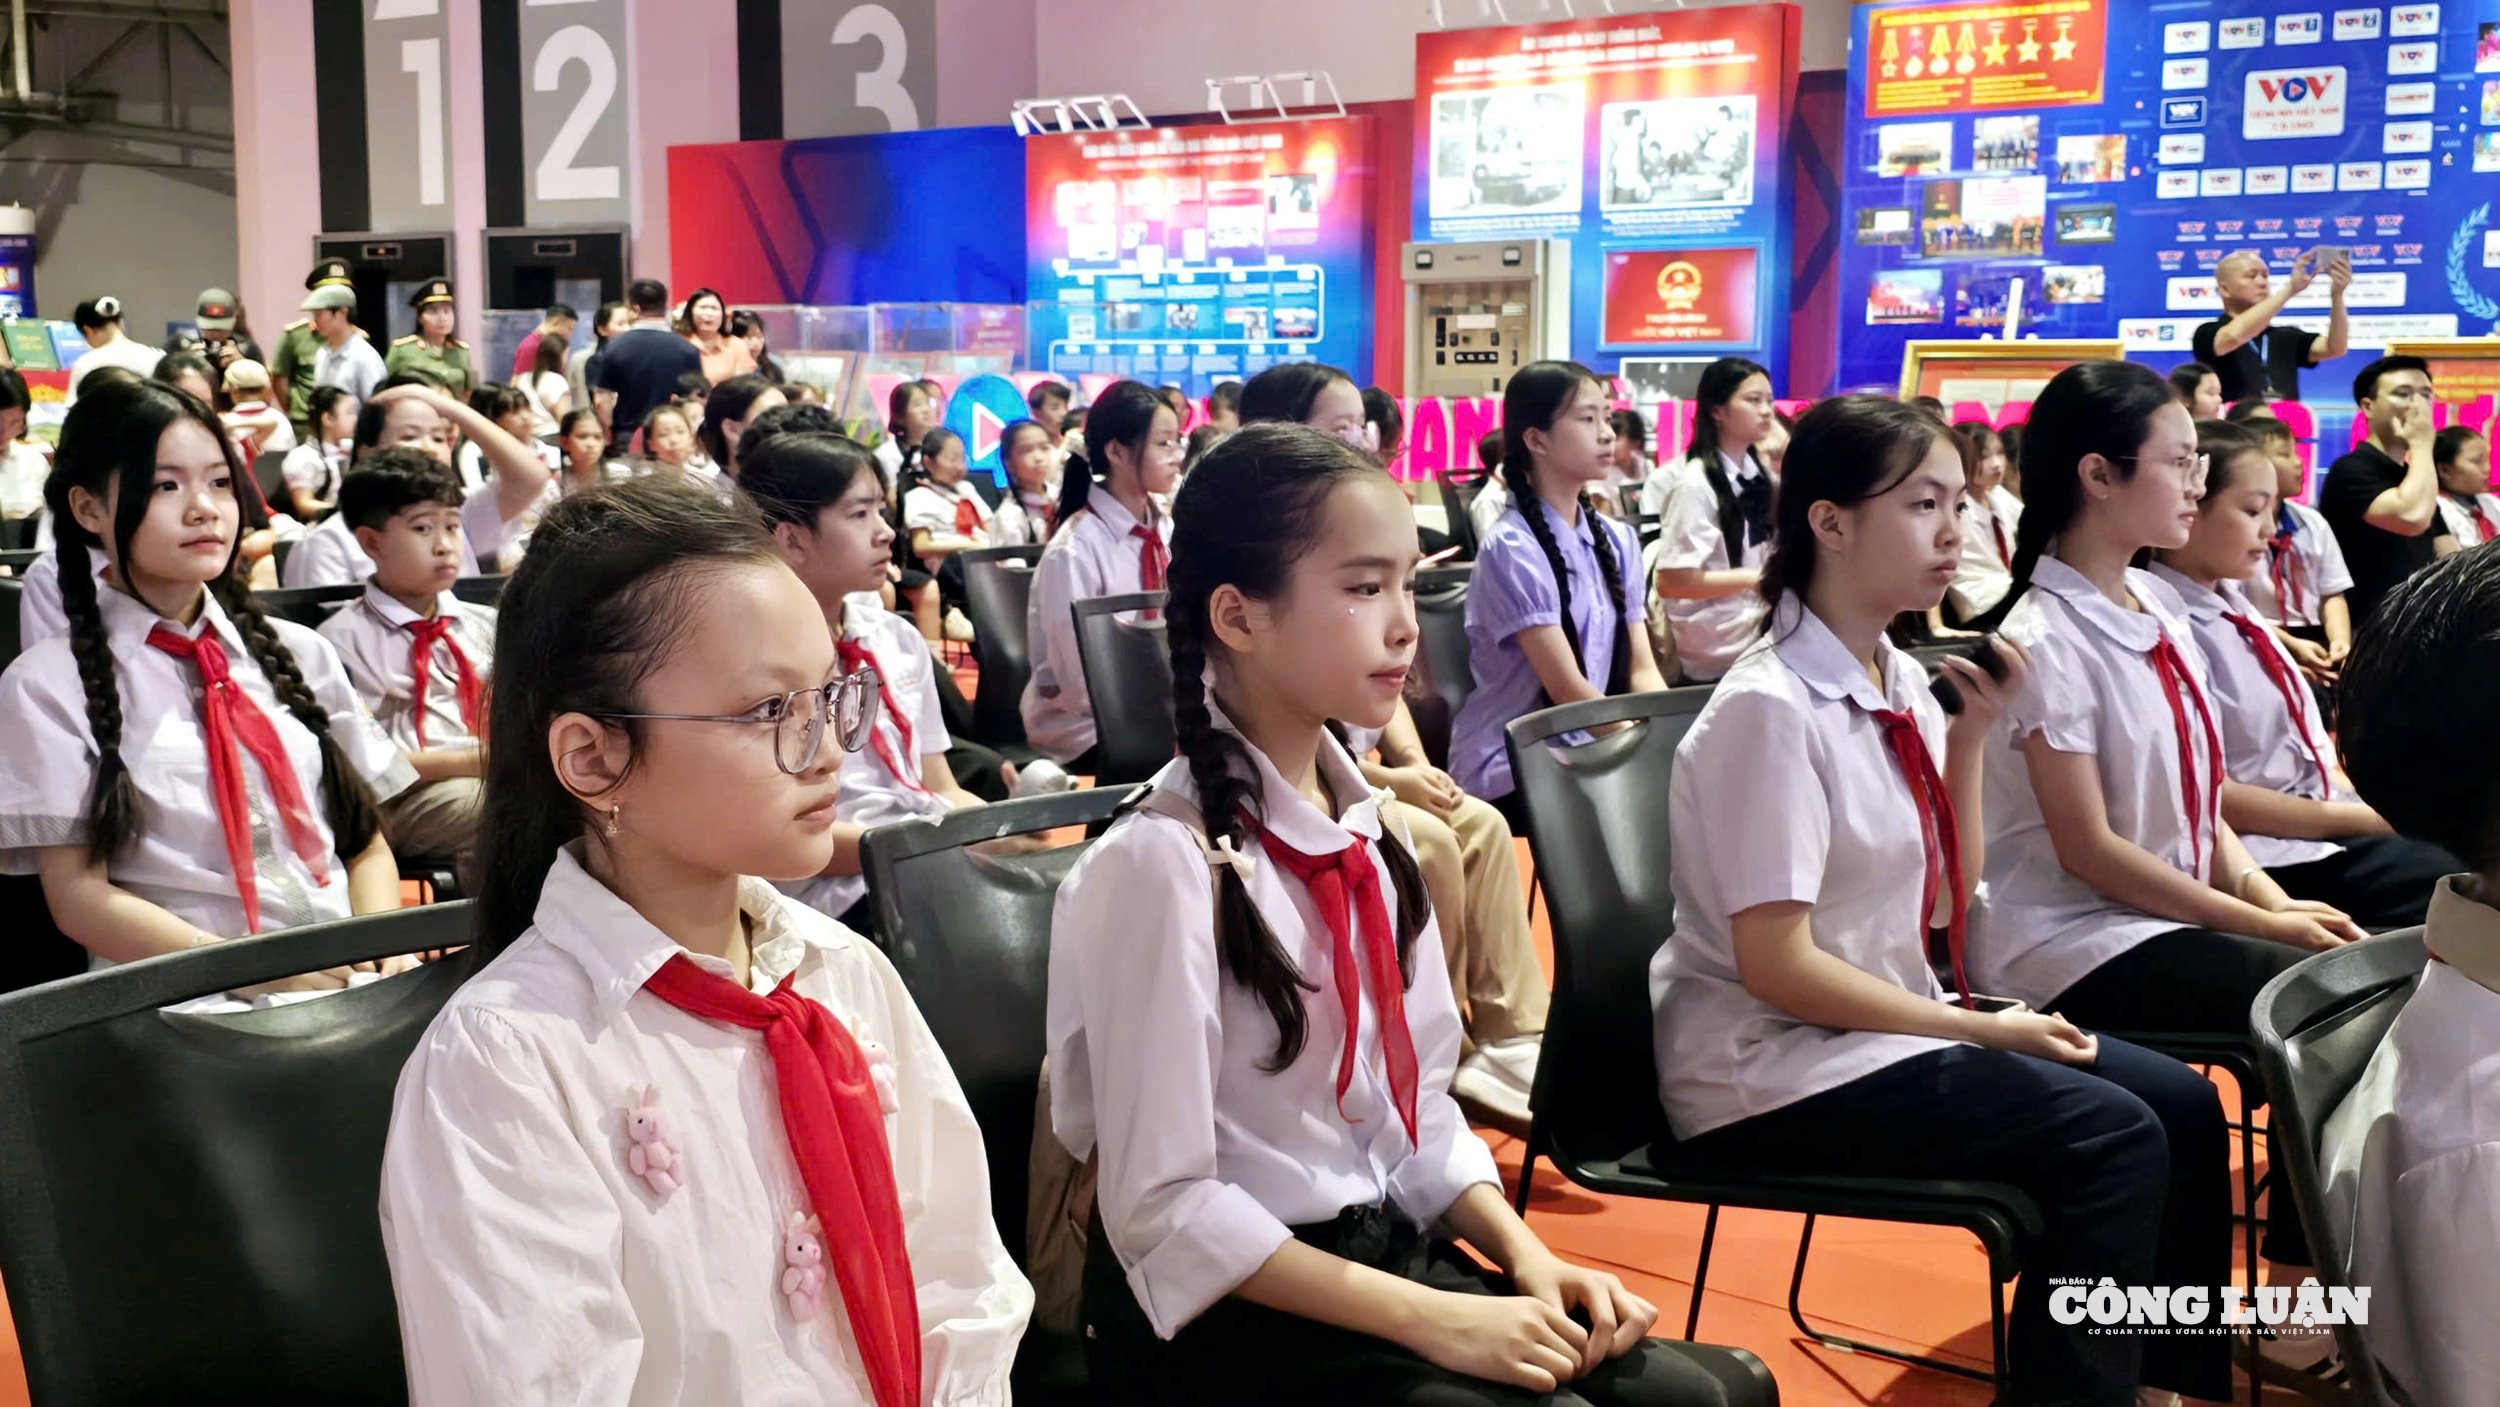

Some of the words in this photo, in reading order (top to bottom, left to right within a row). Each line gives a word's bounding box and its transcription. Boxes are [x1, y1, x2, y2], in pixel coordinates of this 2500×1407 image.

[402, 38, 445, 205] 1
[533, 24, 620, 200] 2
[831, 4, 919, 133] 3
[2257, 73, 2334, 104] VOV
